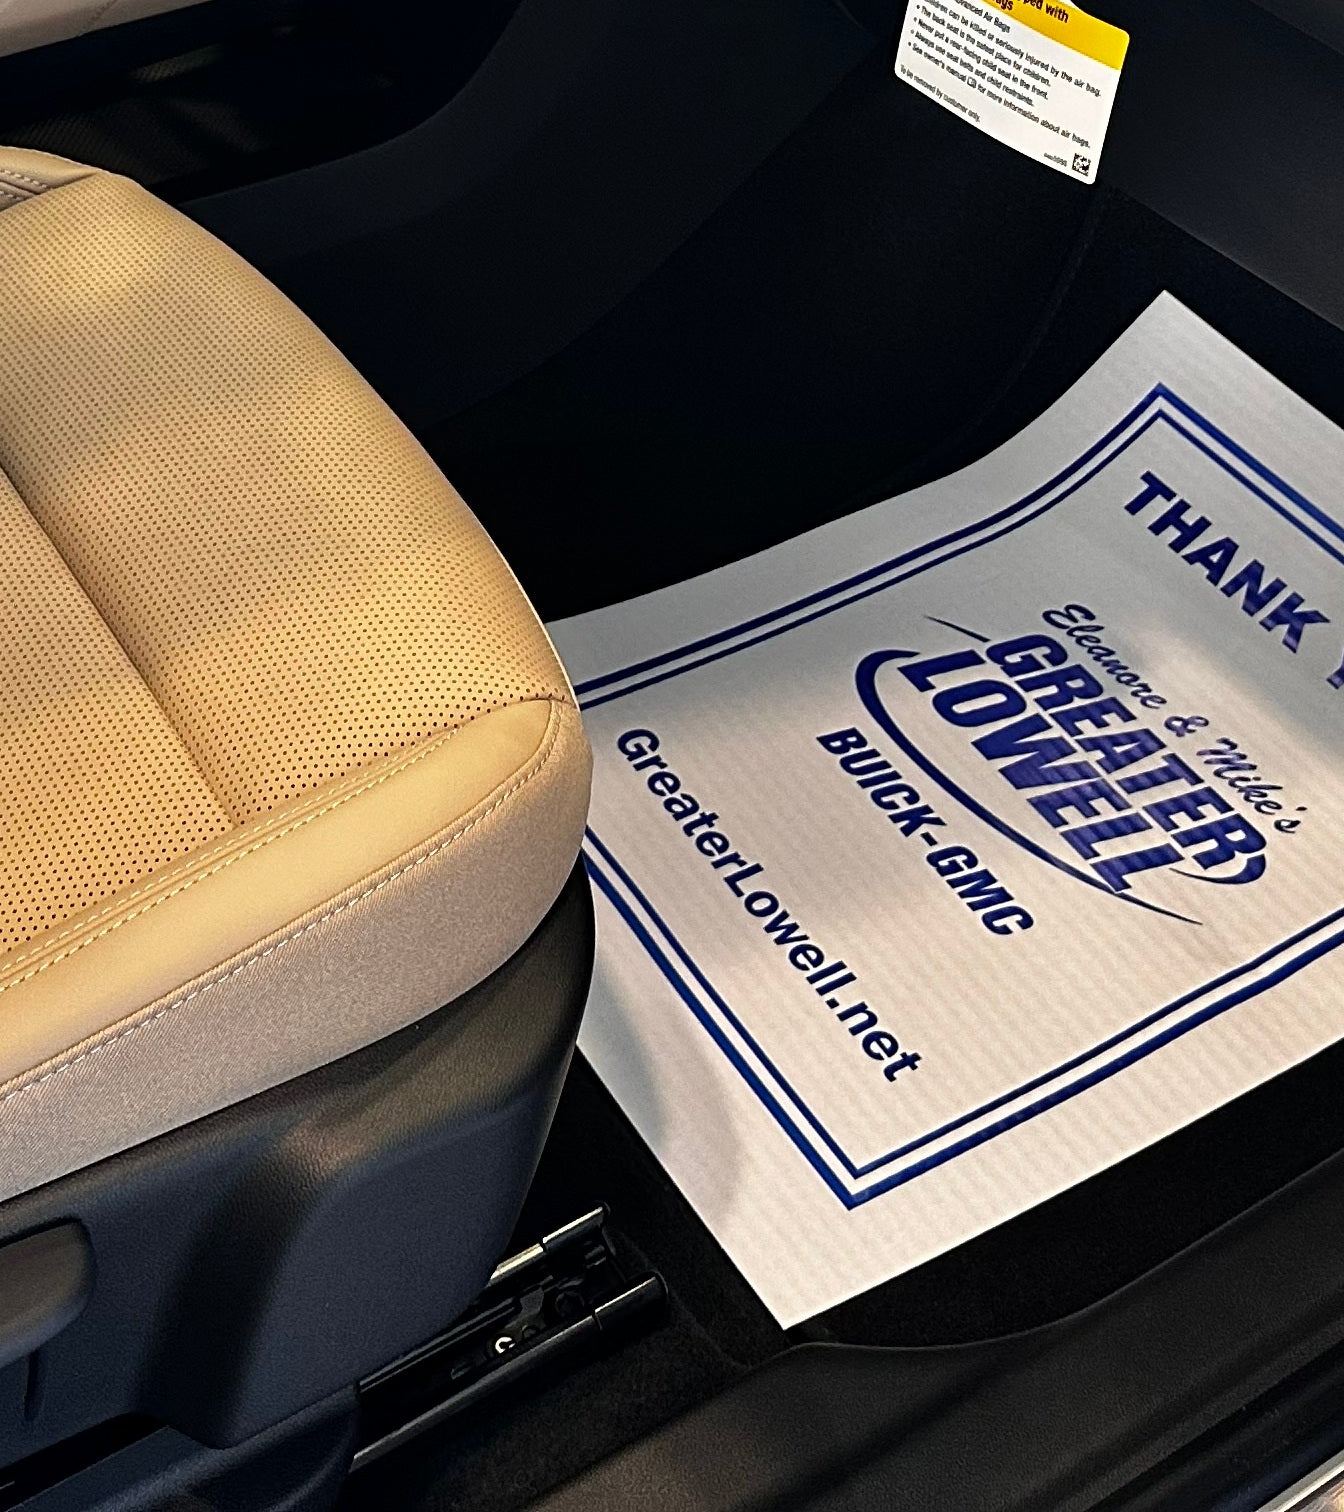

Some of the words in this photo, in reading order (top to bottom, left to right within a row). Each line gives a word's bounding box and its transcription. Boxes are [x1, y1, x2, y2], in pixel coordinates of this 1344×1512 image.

[1045, 2, 1070, 24] with
[1125, 471, 1327, 652] THANK
[817, 728, 1035, 938] BUICK-GMC
[899, 651, 1182, 894] LOWELL
[988, 635, 1263, 883] GREATER
[1042, 603, 1162, 709] Eleanore
[1166, 713, 1201, 740] &
[1197, 737, 1299, 835] Mike's
[617, 727, 921, 1082] GreaterLowell.net
